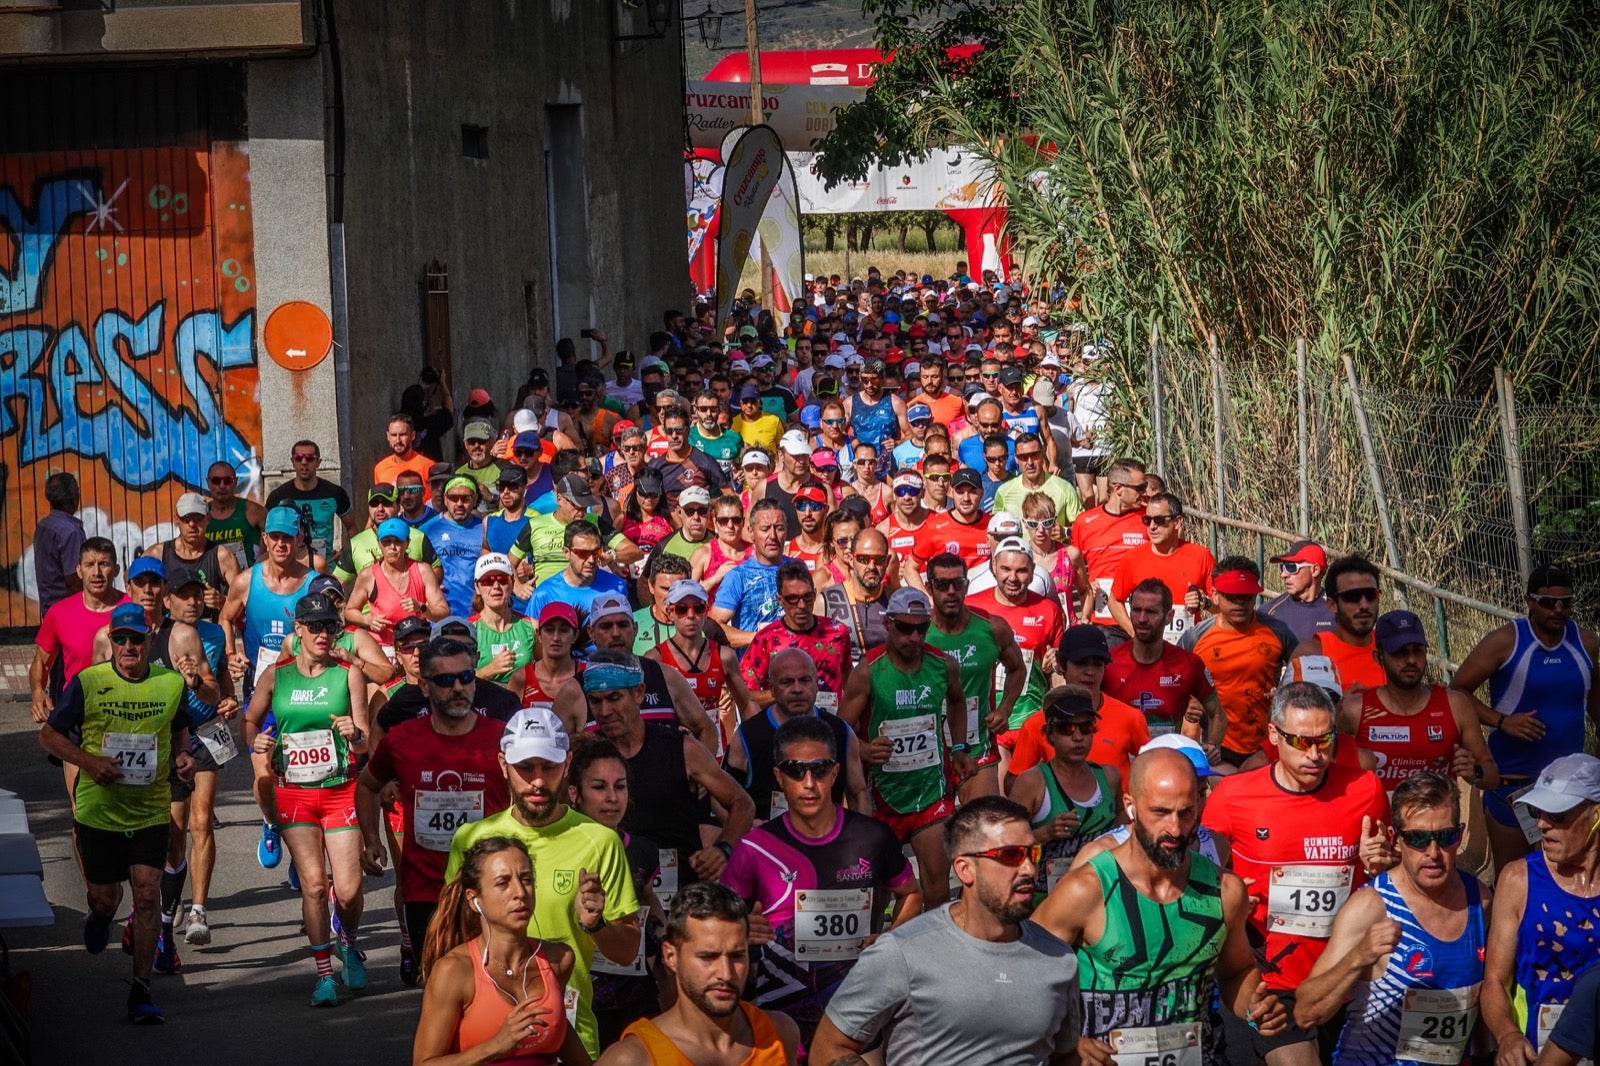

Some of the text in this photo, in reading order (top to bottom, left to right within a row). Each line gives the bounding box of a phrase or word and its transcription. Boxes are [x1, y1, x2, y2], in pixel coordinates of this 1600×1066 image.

[687, 113, 735, 131] Radler
[480, 555, 508, 568] ellesse
[290, 689, 314, 702] ATARFE
[895, 689, 917, 706] ATARFE
[99, 701, 166, 709] ATLETISMO
[102, 708, 164, 722] ALHENDIN
[894, 733, 928, 754] 372
[115, 750, 147, 768] 474
[289, 746, 331, 767] 2098
[428, 811, 469, 832] 484
[1303, 836, 1343, 847] RUNNING
[1289, 889, 1337, 912] 139
[813, 913, 859, 937] 380
[1421, 1012, 1468, 1040] 281
